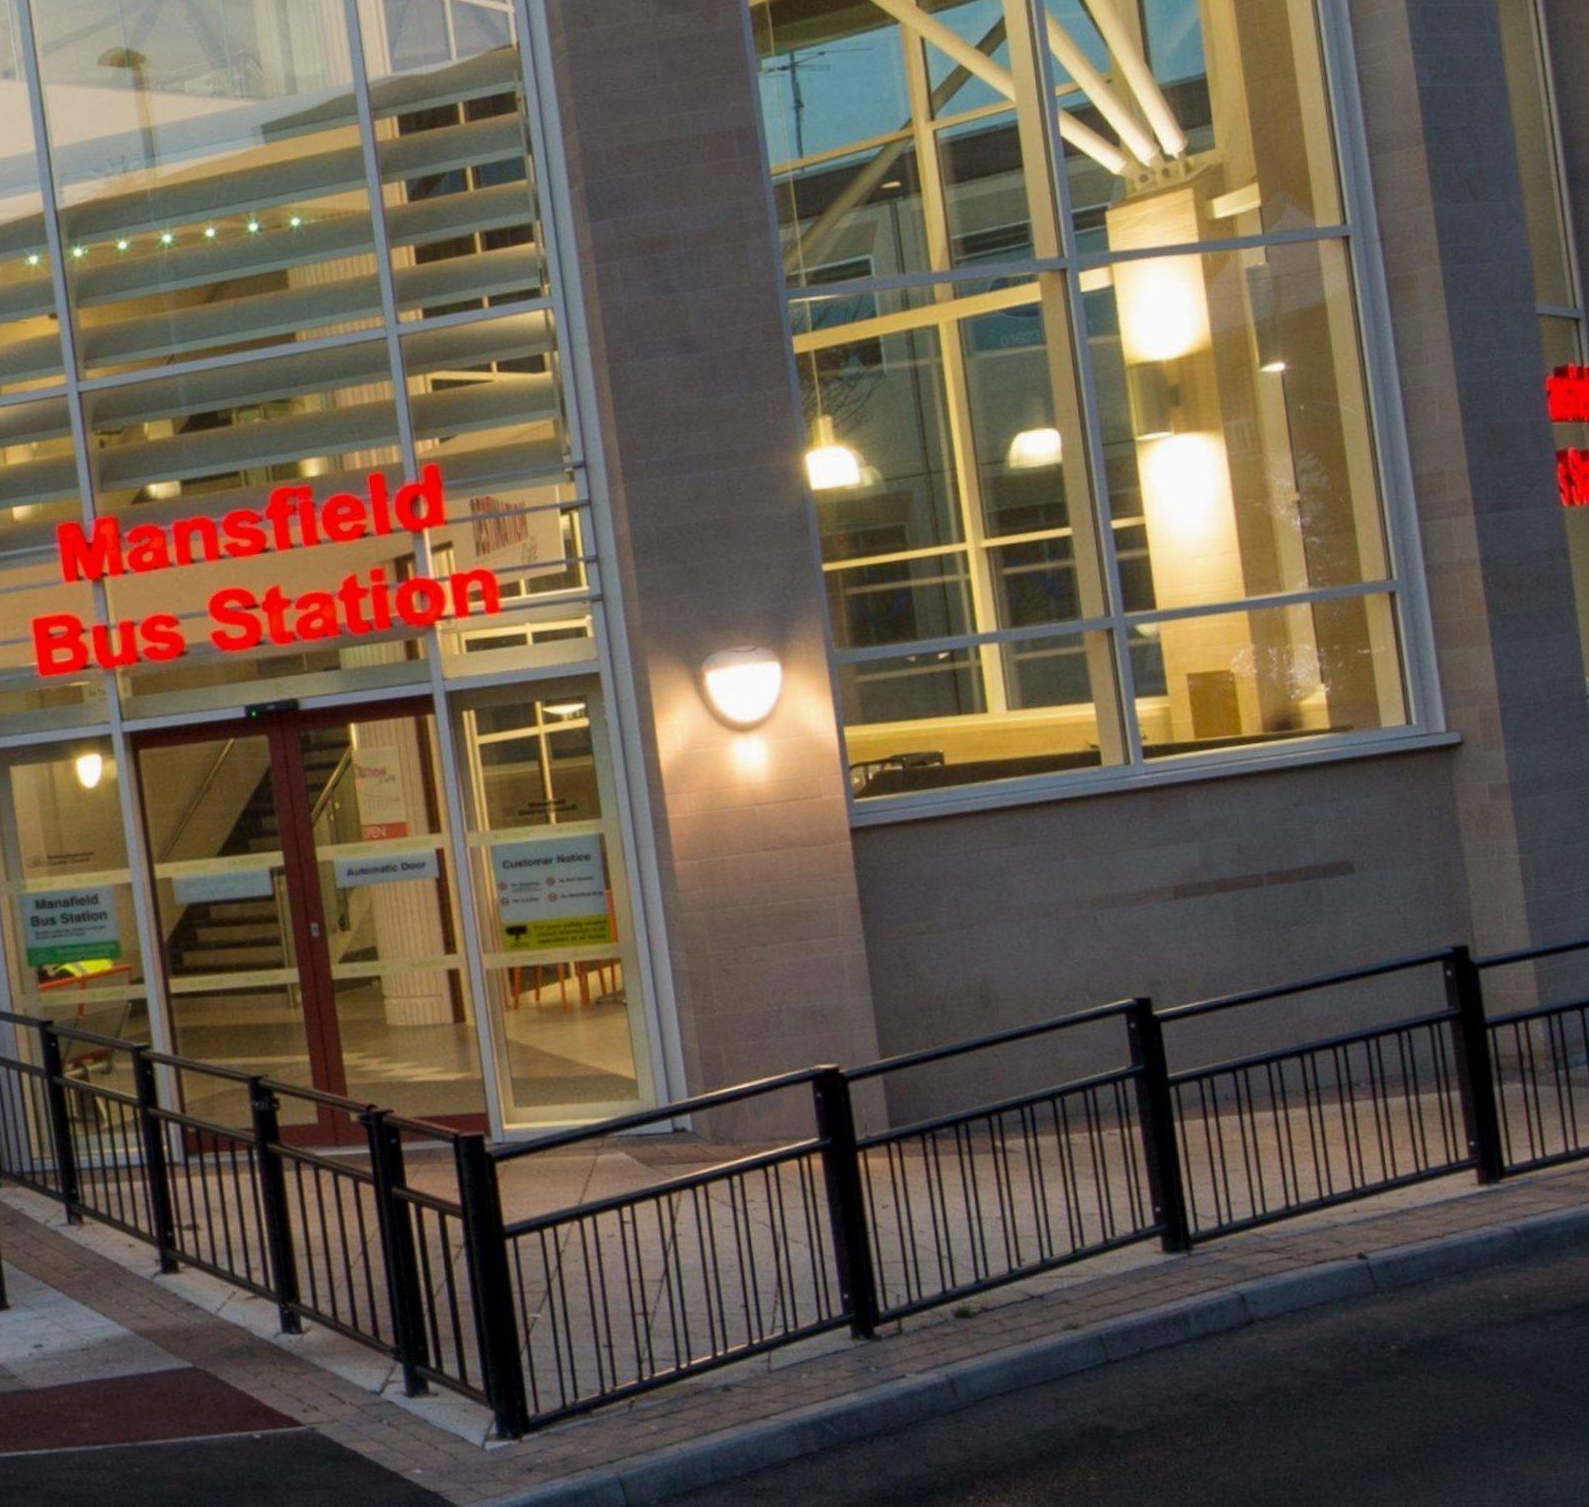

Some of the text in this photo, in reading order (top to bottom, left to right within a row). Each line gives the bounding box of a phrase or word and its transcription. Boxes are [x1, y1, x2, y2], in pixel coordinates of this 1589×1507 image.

[56, 462, 446, 583] Mansfield
[31, 567, 501, 678] Bus Station
[346, 860, 426, 877] Automatic Door
[502, 852, 592, 870] Customer Notice
[34, 893, 99, 911] Mansfield
[30, 910, 108, 928] Bus Station
